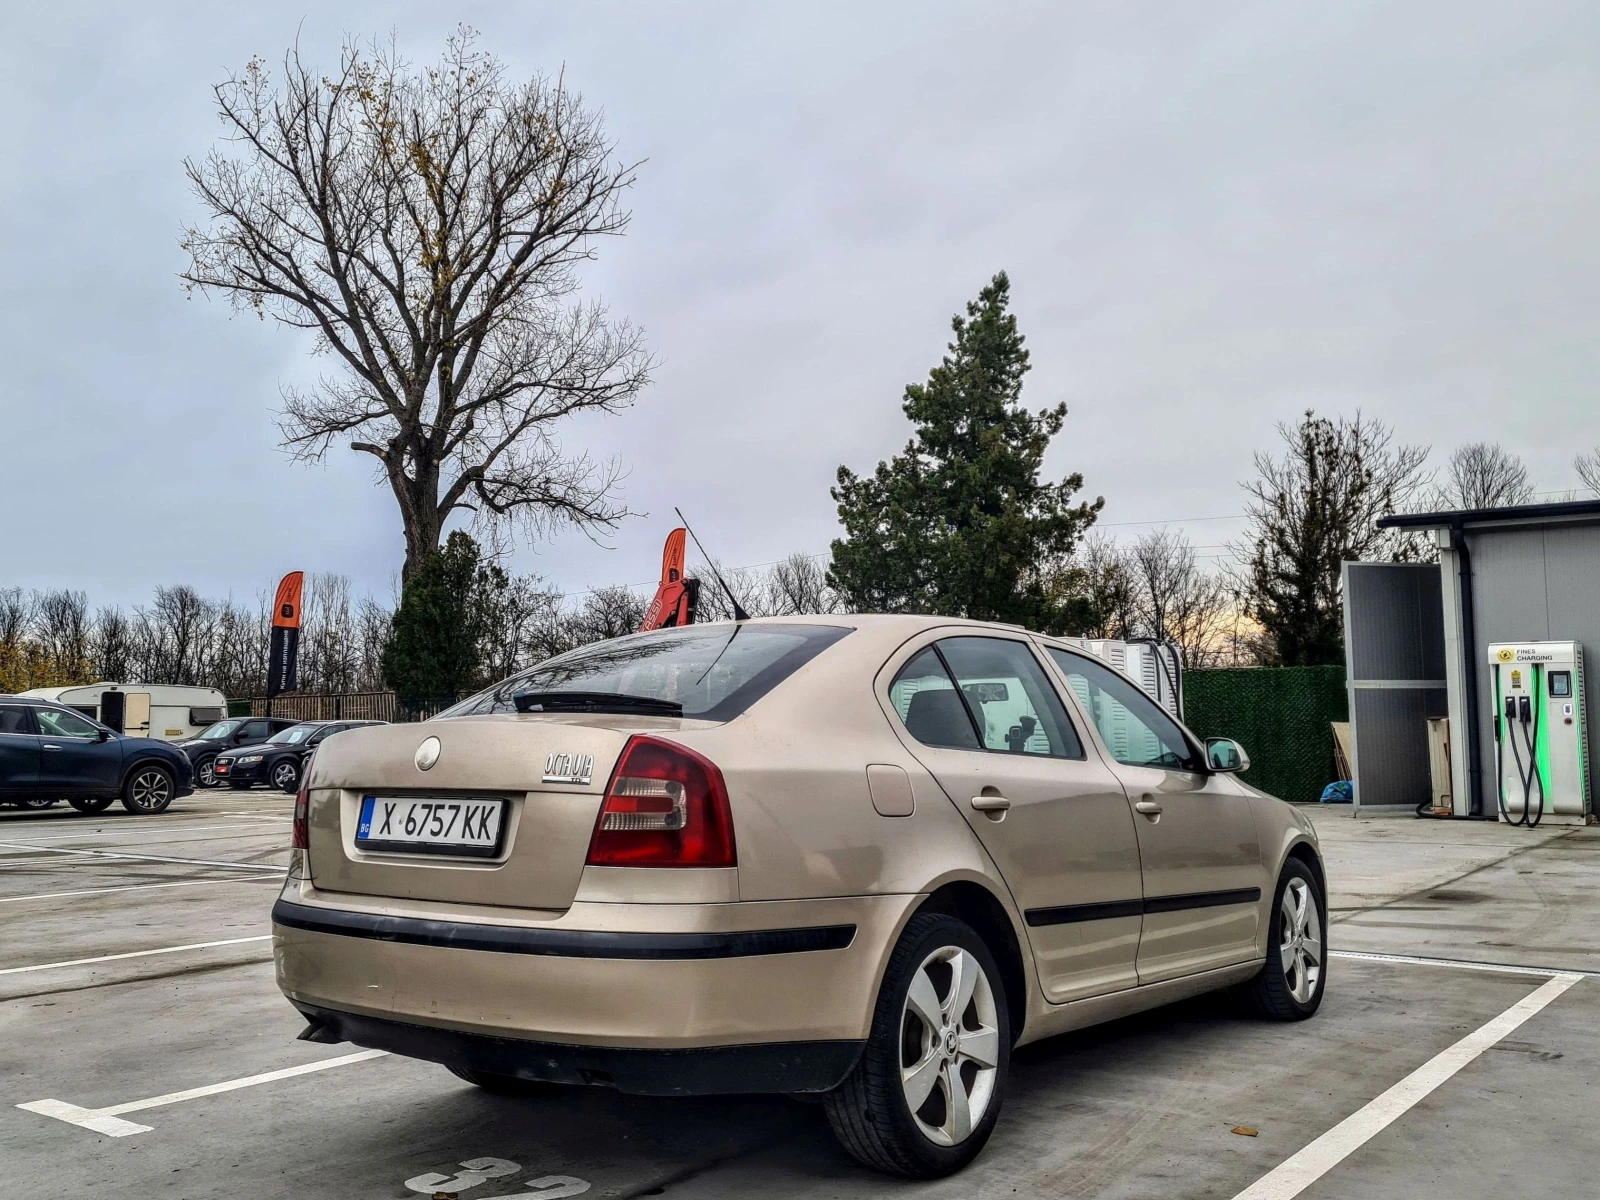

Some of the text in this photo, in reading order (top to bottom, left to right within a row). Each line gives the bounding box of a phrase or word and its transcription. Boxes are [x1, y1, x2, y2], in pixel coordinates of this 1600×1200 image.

[544, 753, 594, 776] OCTAVIA
[360, 823, 370, 833] BG
[379, 802, 496, 841] X 6757 KK
